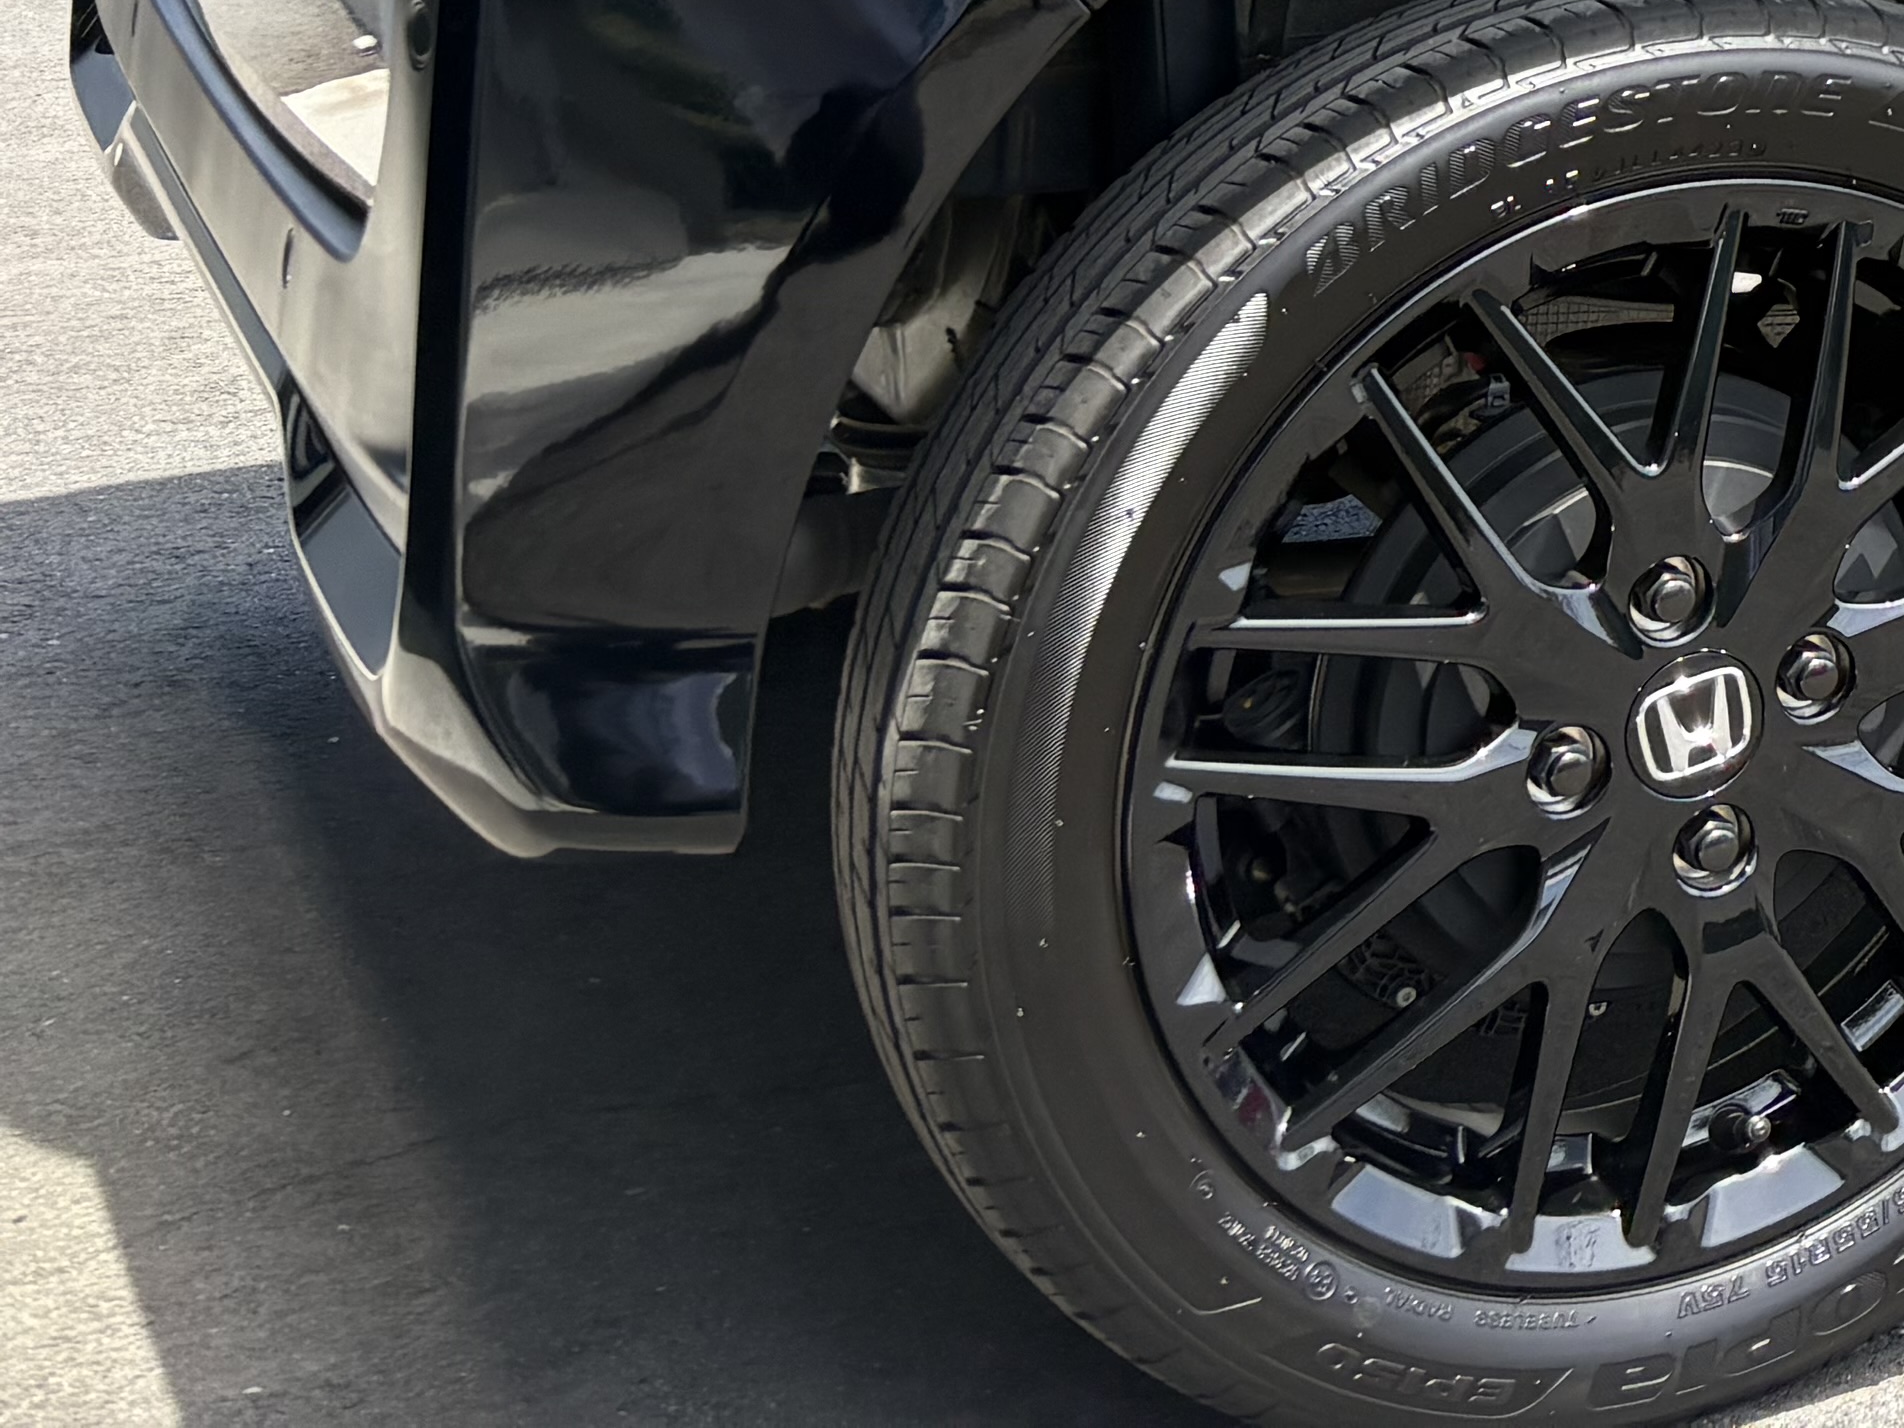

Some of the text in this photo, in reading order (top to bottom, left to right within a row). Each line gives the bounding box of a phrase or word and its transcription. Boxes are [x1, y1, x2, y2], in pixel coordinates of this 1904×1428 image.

[1305, 70, 1853, 296] BRIDGESTONE
[1676, 1274, 1753, 1320] 75V
[1316, 1342, 1518, 1404] EP150
